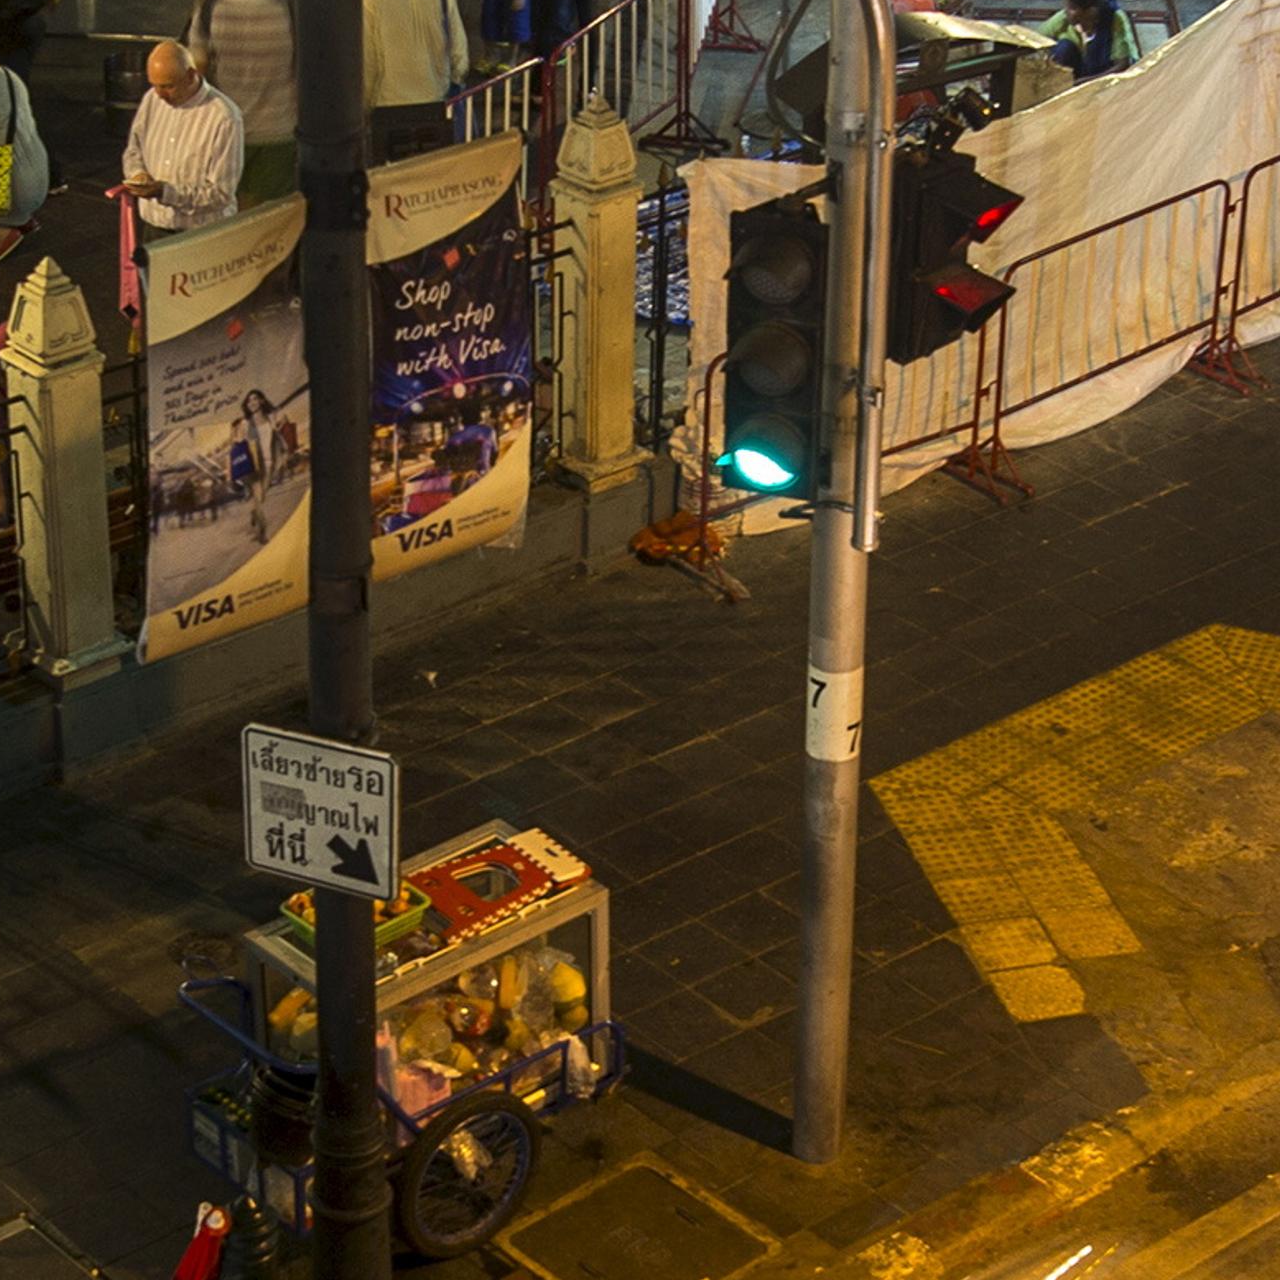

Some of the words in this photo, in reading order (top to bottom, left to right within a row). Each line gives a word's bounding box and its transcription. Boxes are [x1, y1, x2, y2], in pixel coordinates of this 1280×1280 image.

[395, 278, 451, 310] Shop
[394, 302, 495, 341] non-stop
[397, 344, 453, 376] with
[394, 518, 454, 554] VISA
[172, 594, 235, 630] VISA
[810, 677, 827, 708] 7
[846, 721, 861, 753] 7
[264, 822, 312, 867] ที่นี่
